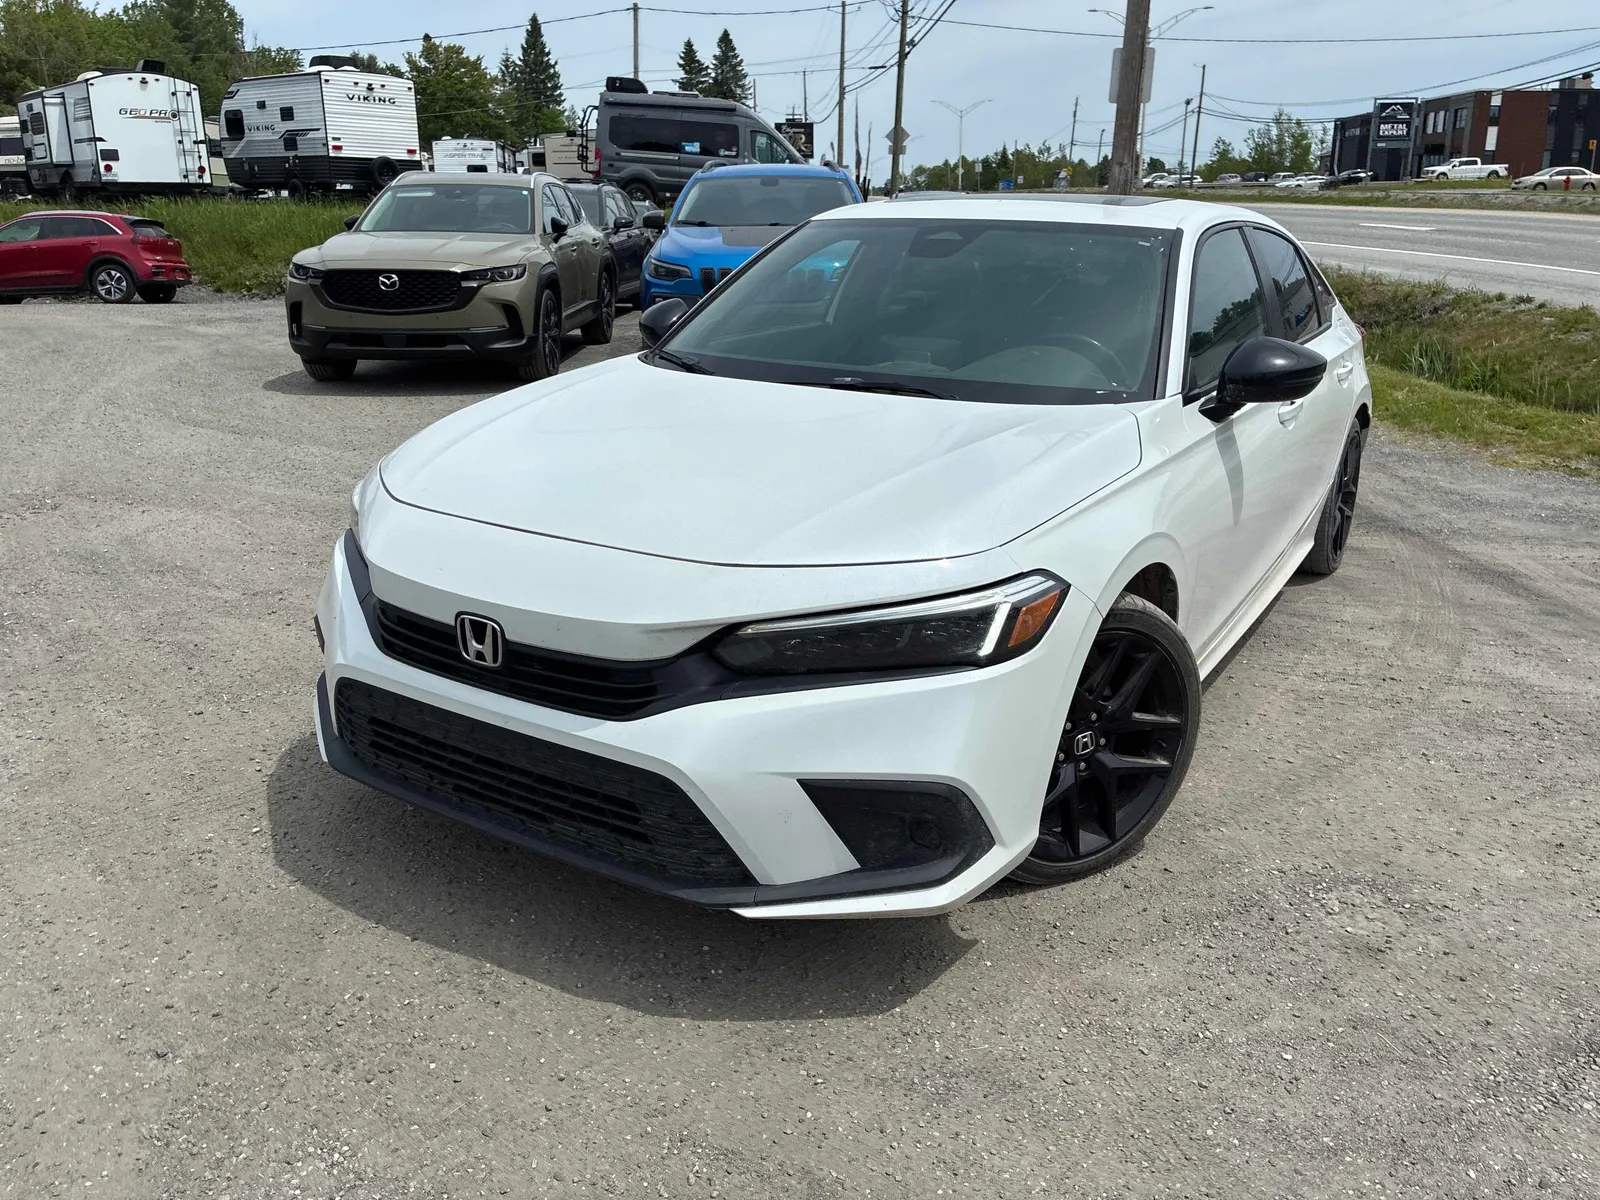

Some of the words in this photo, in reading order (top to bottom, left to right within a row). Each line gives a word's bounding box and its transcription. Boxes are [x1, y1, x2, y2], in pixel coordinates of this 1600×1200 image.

[345, 93, 396, 105] VIKING
[118, 107, 148, 116] GEO
[246, 124, 275, 132] VIKING
